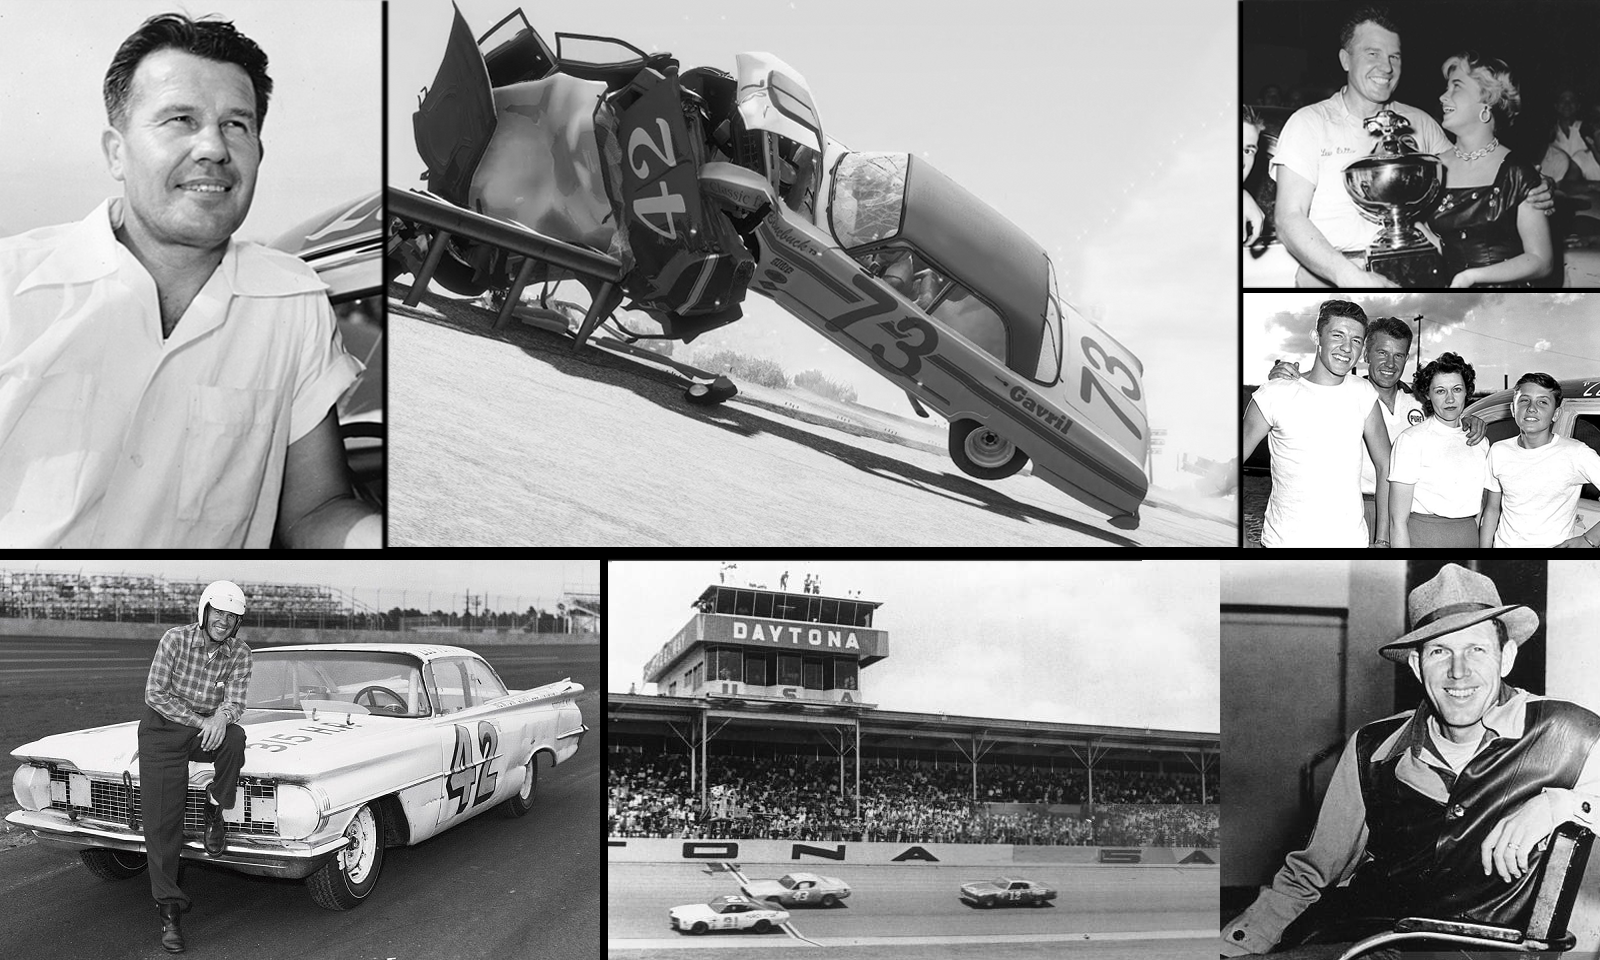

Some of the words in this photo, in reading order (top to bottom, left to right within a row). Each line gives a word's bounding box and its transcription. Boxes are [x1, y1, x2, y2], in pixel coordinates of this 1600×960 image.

[628, 117, 686, 240] 42
[709, 182, 751, 206] Classic
[825, 273, 939, 377] 73
[1009, 385, 1073, 435] Gavril
[1080, 336, 1142, 440] 73
[1410, 414, 1422, 423] PURE
[733, 621, 860, 650] DAYTONA
[246, 733, 313, 753] 315
[446, 720, 499, 815] 42
